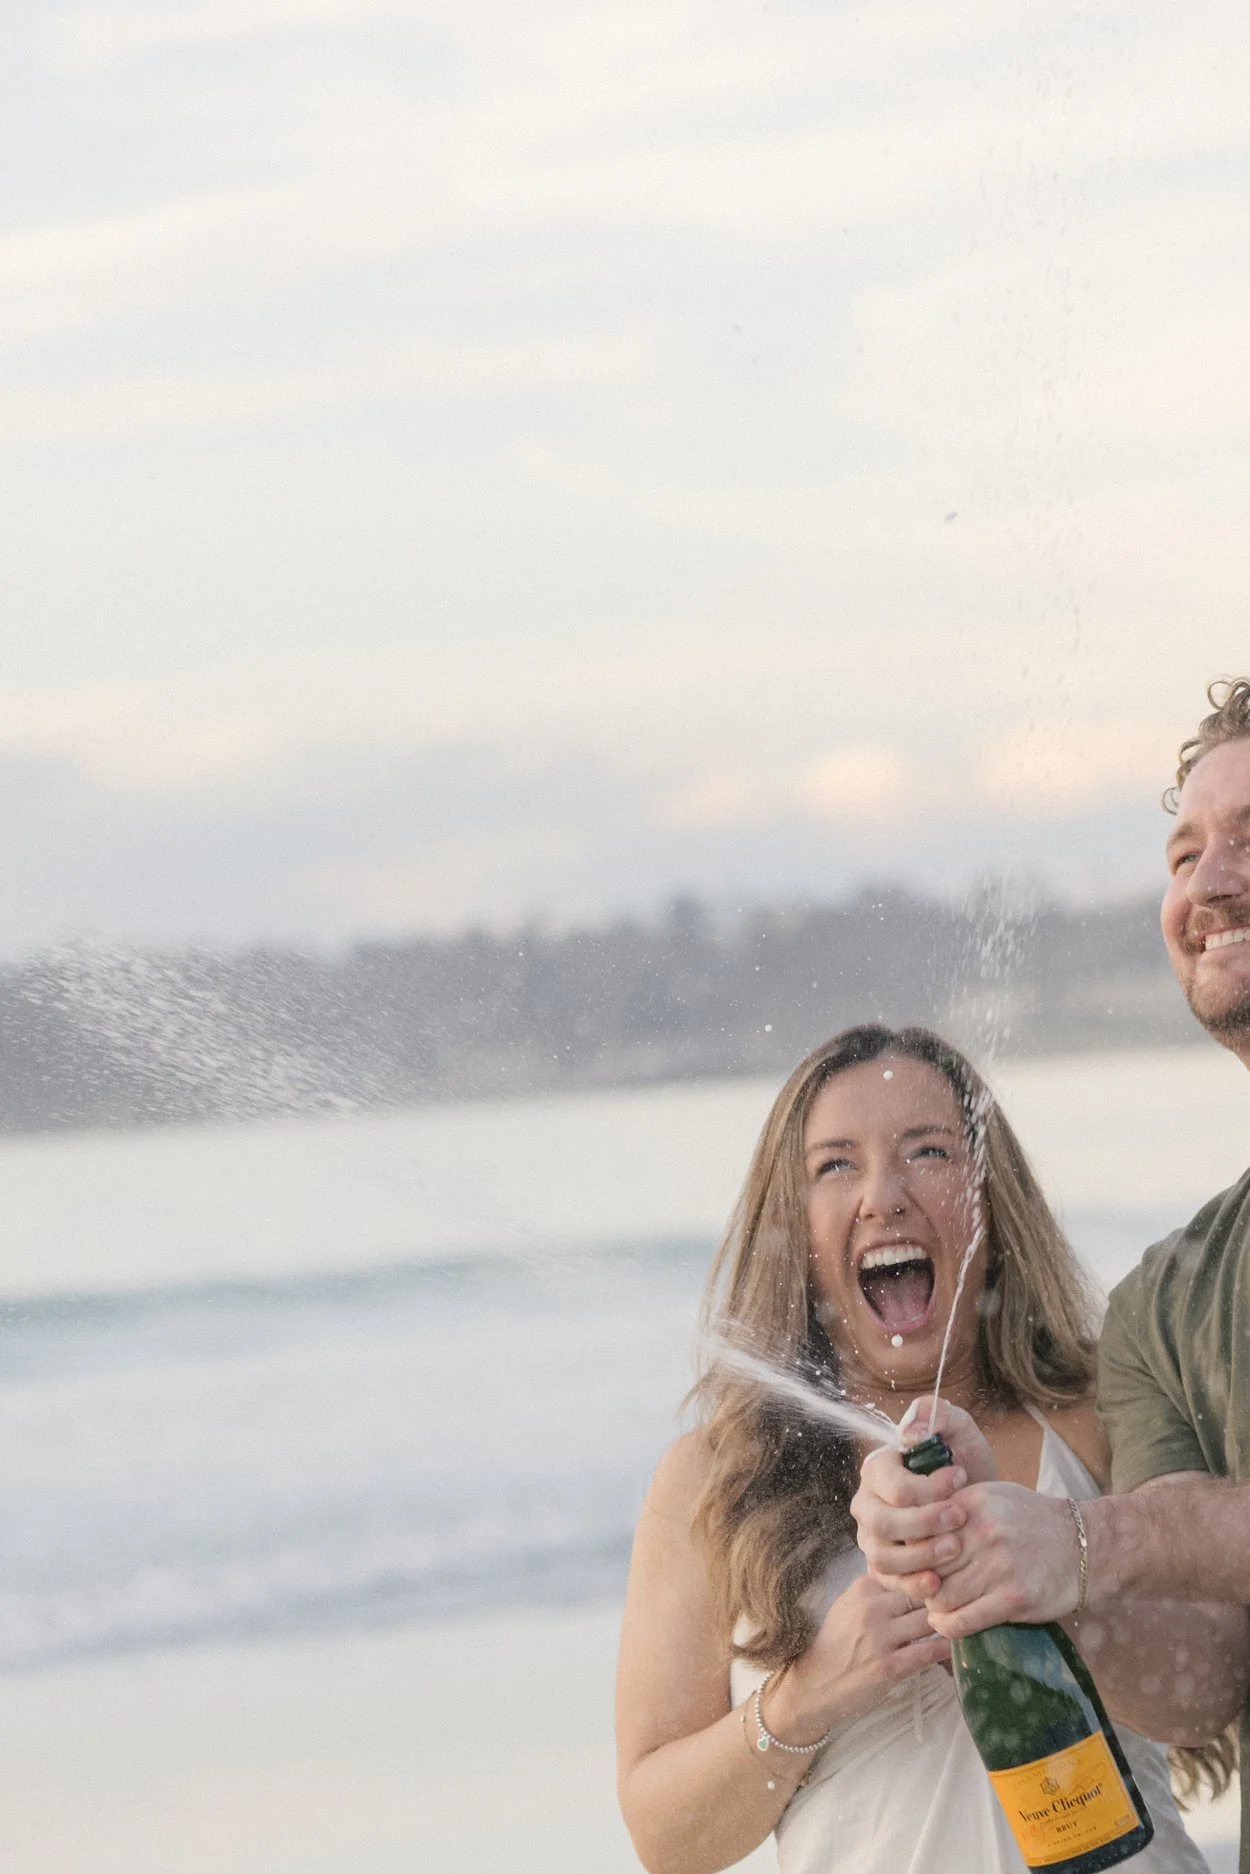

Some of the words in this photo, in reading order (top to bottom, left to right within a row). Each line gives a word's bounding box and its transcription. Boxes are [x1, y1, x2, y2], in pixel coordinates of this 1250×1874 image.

[1018, 1808, 1050, 1822] Veuve
[1052, 1786, 1102, 1812] Clicquot
[1056, 1821, 1078, 1833] BRUT
